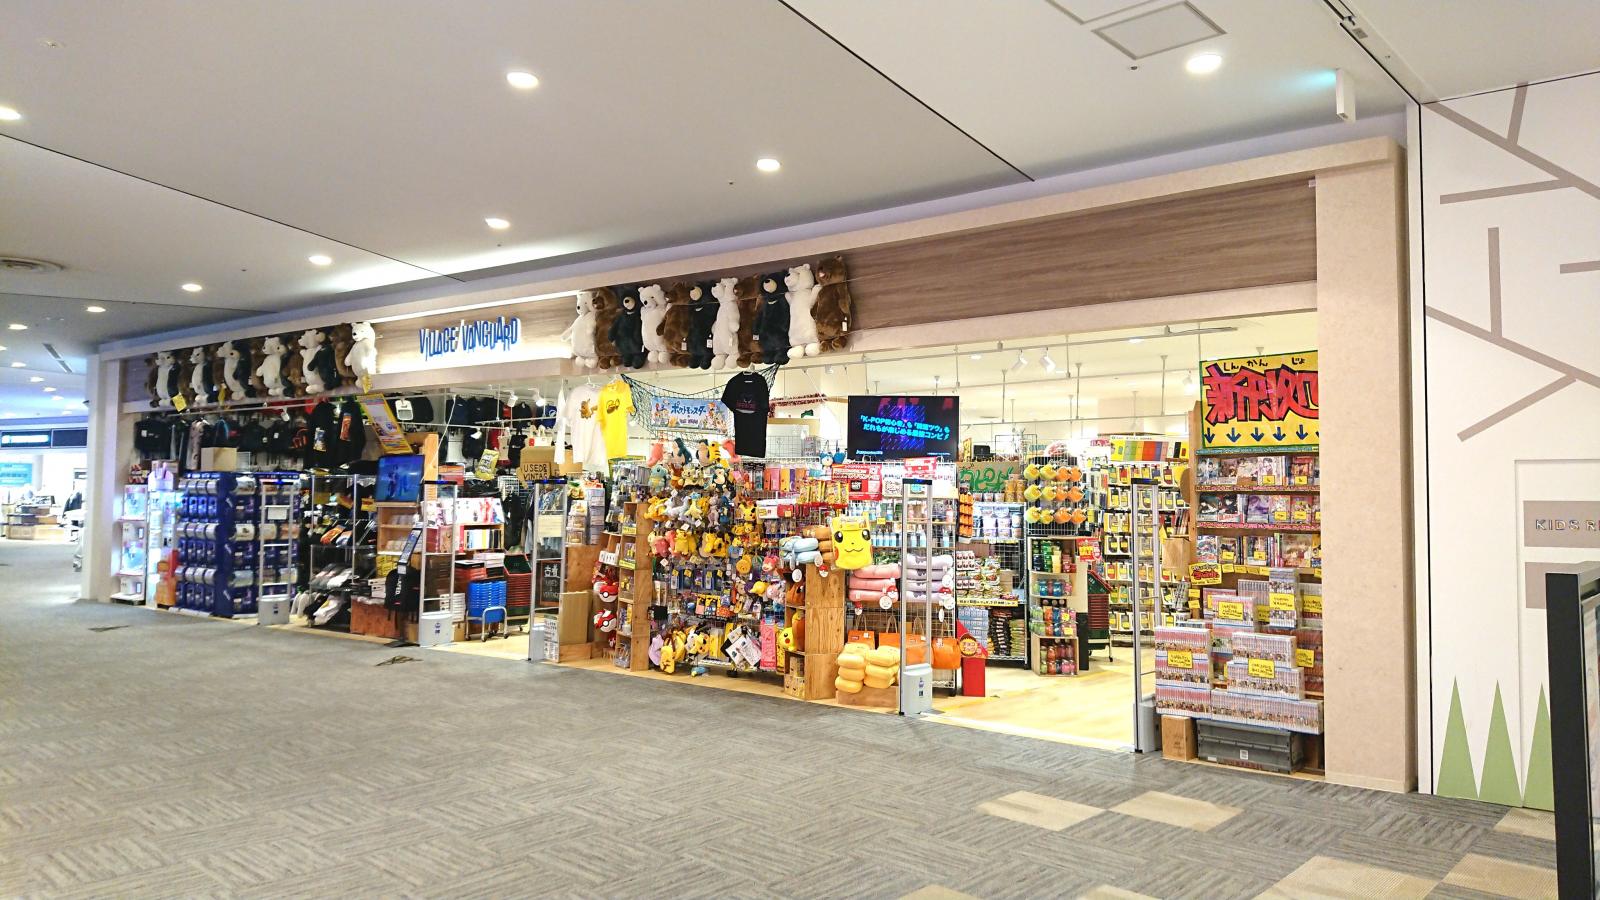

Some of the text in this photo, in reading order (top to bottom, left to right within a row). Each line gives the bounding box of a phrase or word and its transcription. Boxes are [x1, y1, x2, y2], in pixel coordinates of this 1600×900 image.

[461, 316, 519, 352] VANGUARD
[1535, 519, 1600, 531] KIDS R
